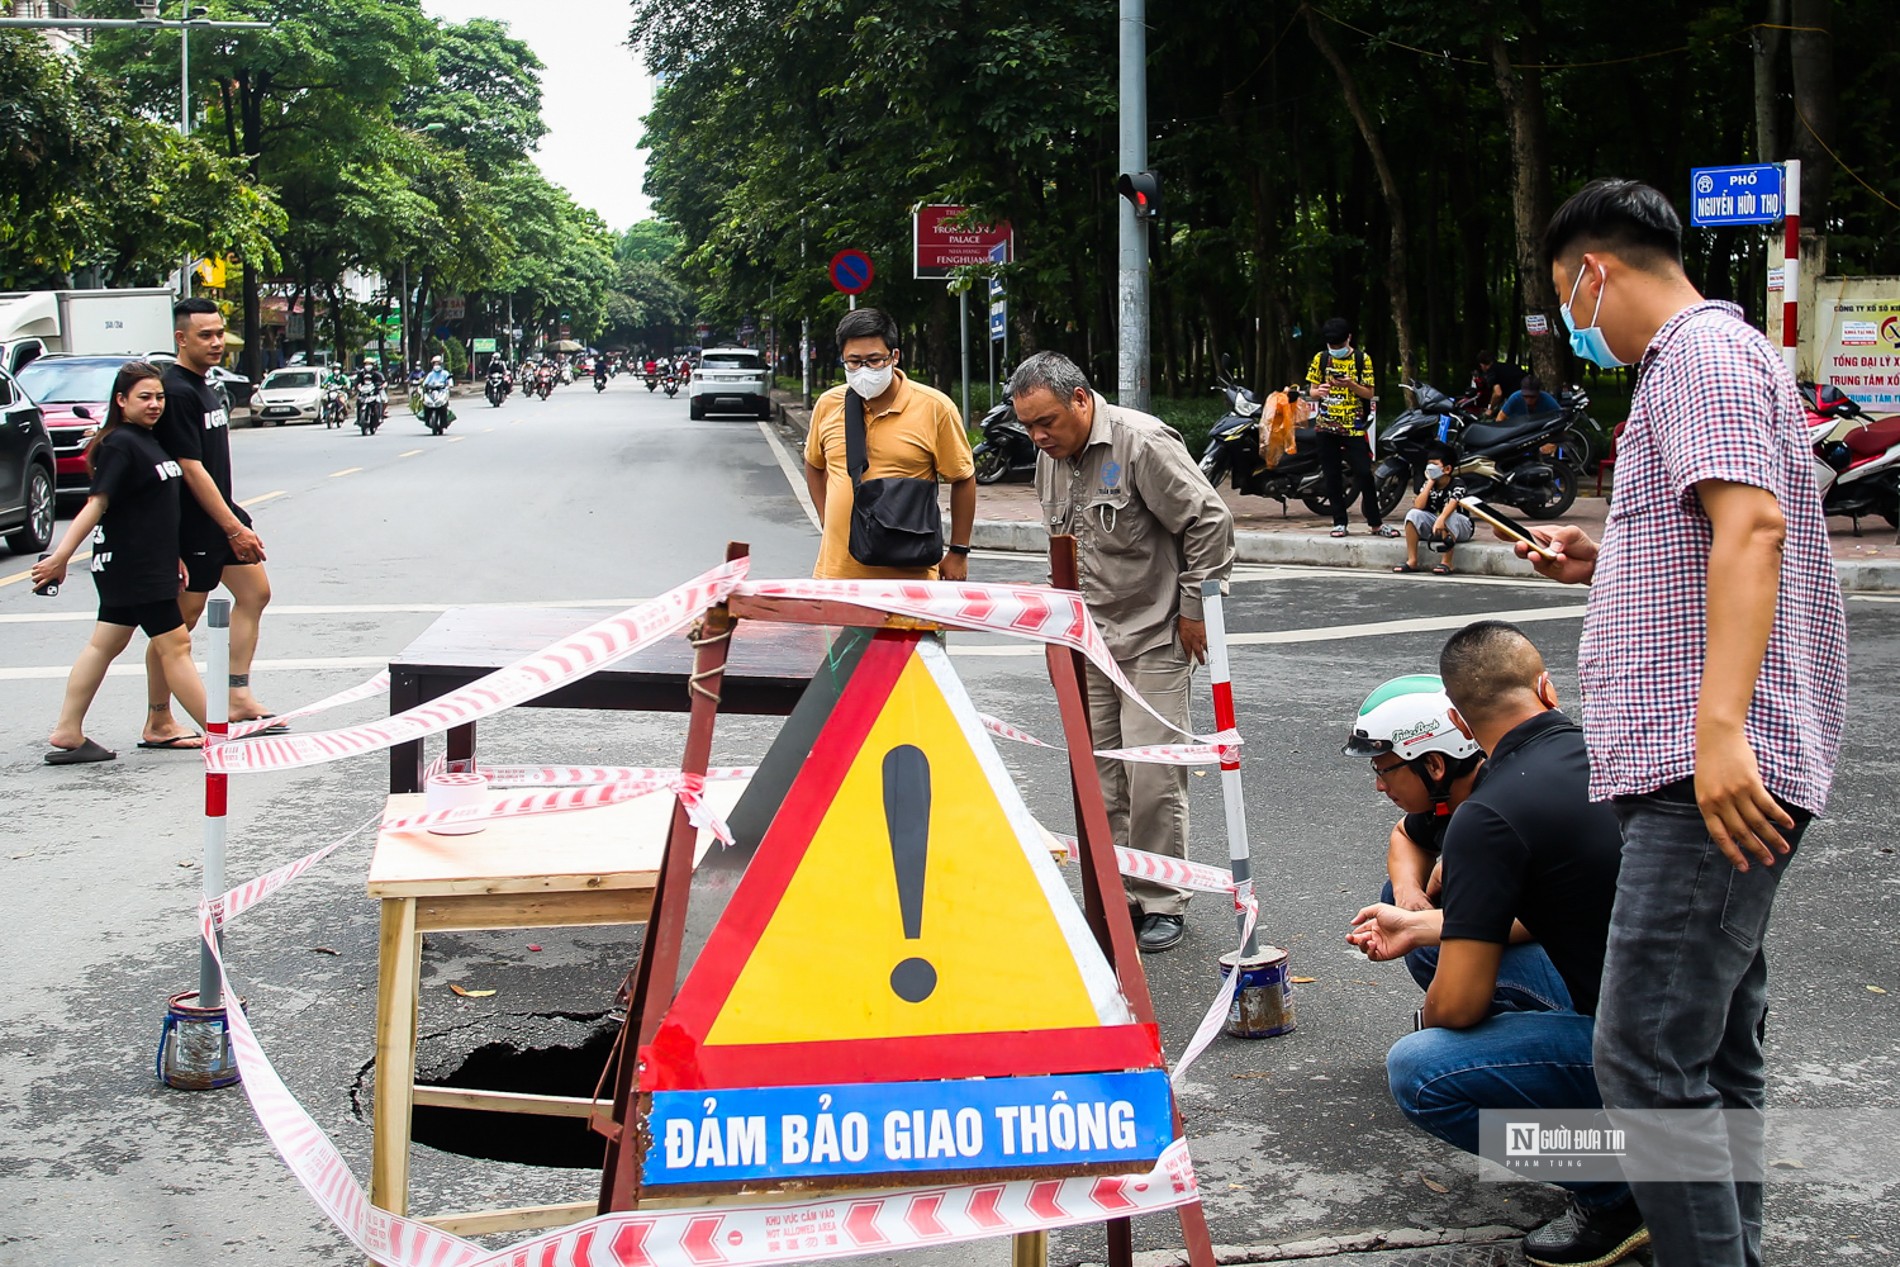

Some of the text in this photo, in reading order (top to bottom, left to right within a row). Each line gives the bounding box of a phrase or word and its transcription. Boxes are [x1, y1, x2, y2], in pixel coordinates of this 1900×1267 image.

[1729, 170, 1758, 186] PHỐ
[1697, 189, 1734, 217] NGUYỄN
[1760, 193, 1779, 217] THỌ
[949, 236, 980, 244] PALACE
[1829, 375, 1861, 386] TRUNG
[1863, 374, 1885, 386] TÂM
[664, 1090, 1137, 1169] ĐẢM BẢO GIAO THÔNG
